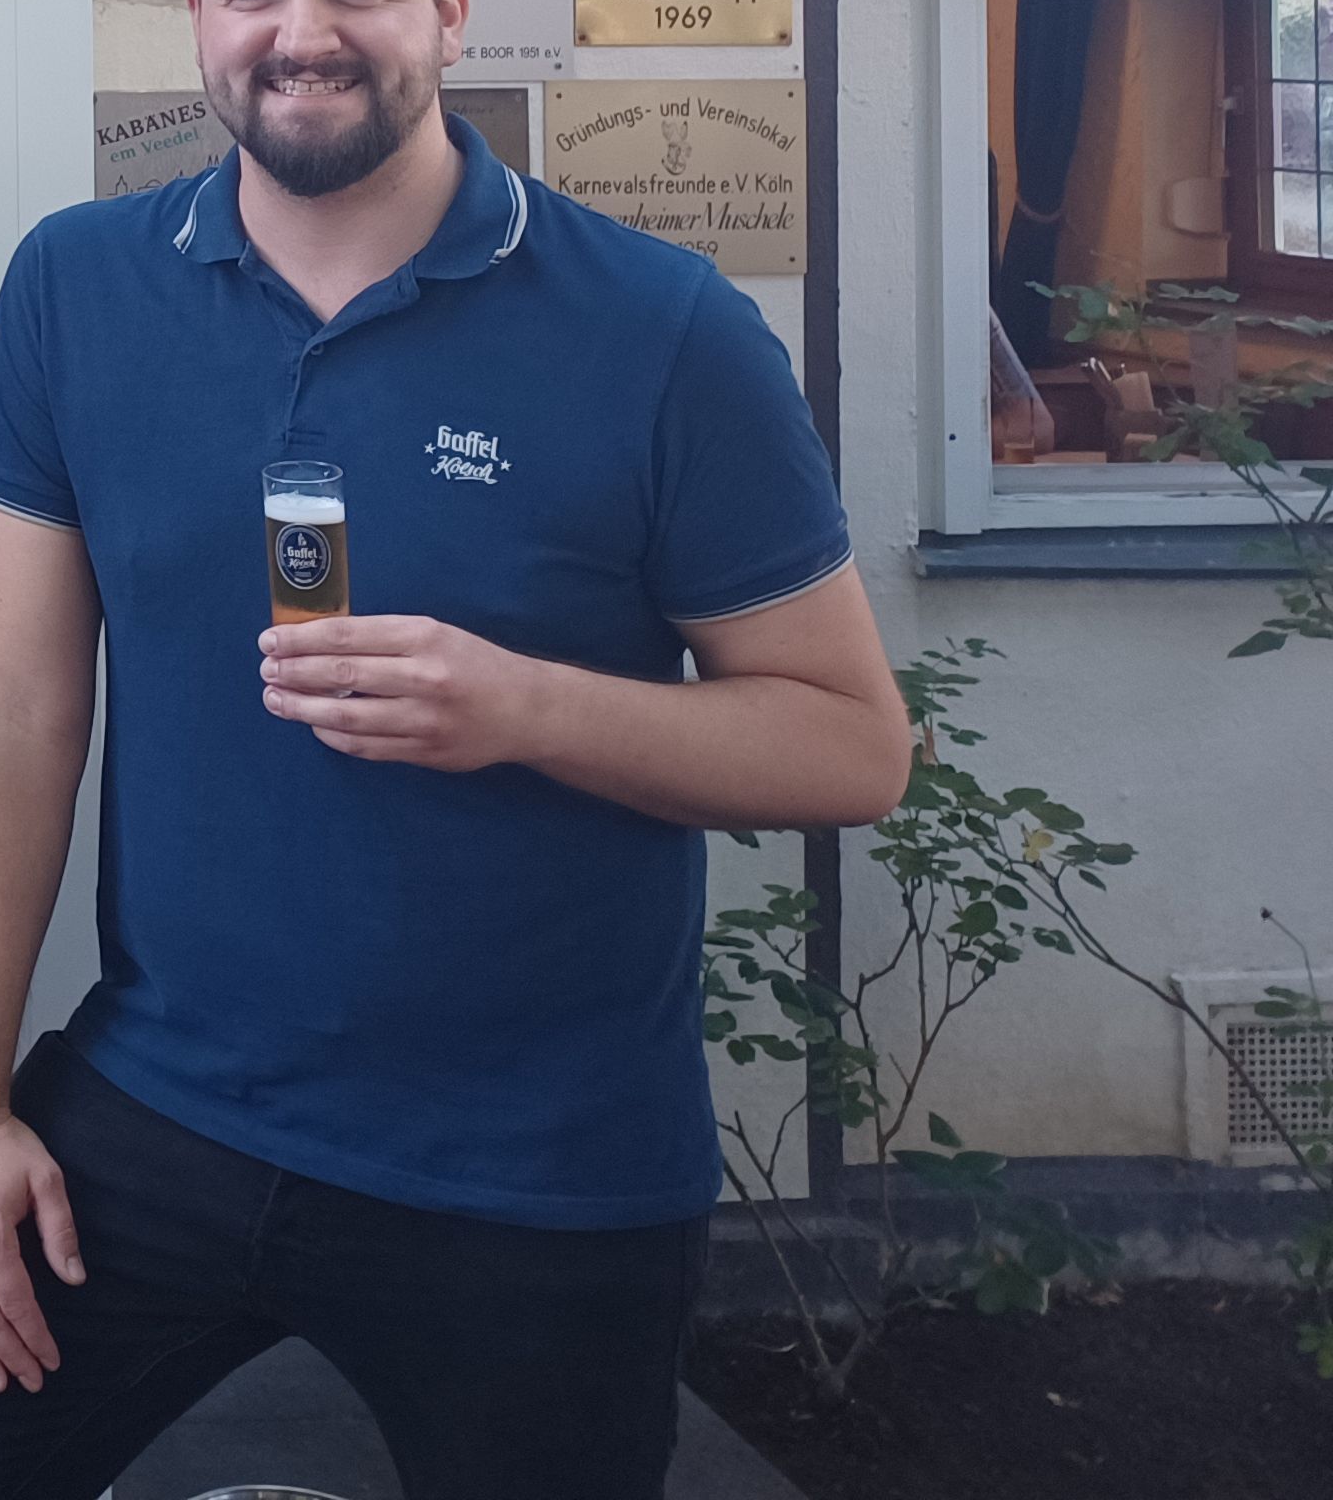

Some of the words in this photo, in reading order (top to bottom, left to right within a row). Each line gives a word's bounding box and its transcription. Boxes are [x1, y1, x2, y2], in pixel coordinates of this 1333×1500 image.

[655, 6, 712, 29] 1969
[480, 46, 514, 59] BOOR
[519, 46, 540, 59] 1951
[97, 101, 206, 146] KABÄNES
[556, 106, 651, 152] Gründungs-
[660, 98, 690, 117] und
[697, 97, 796, 152] Vereinslokal
[110, 148, 136, 163] em
[141, 127, 199, 154] Veedel
[559, 174, 716, 195] Karnevalsfreunde
[755, 173, 793, 194] Köln
[699, 201, 795, 231] Muschele
[437, 425, 499, 461] Gaffel
[431, 455, 498, 485] Kölsch
[287, 546, 318, 559] Gaffel
